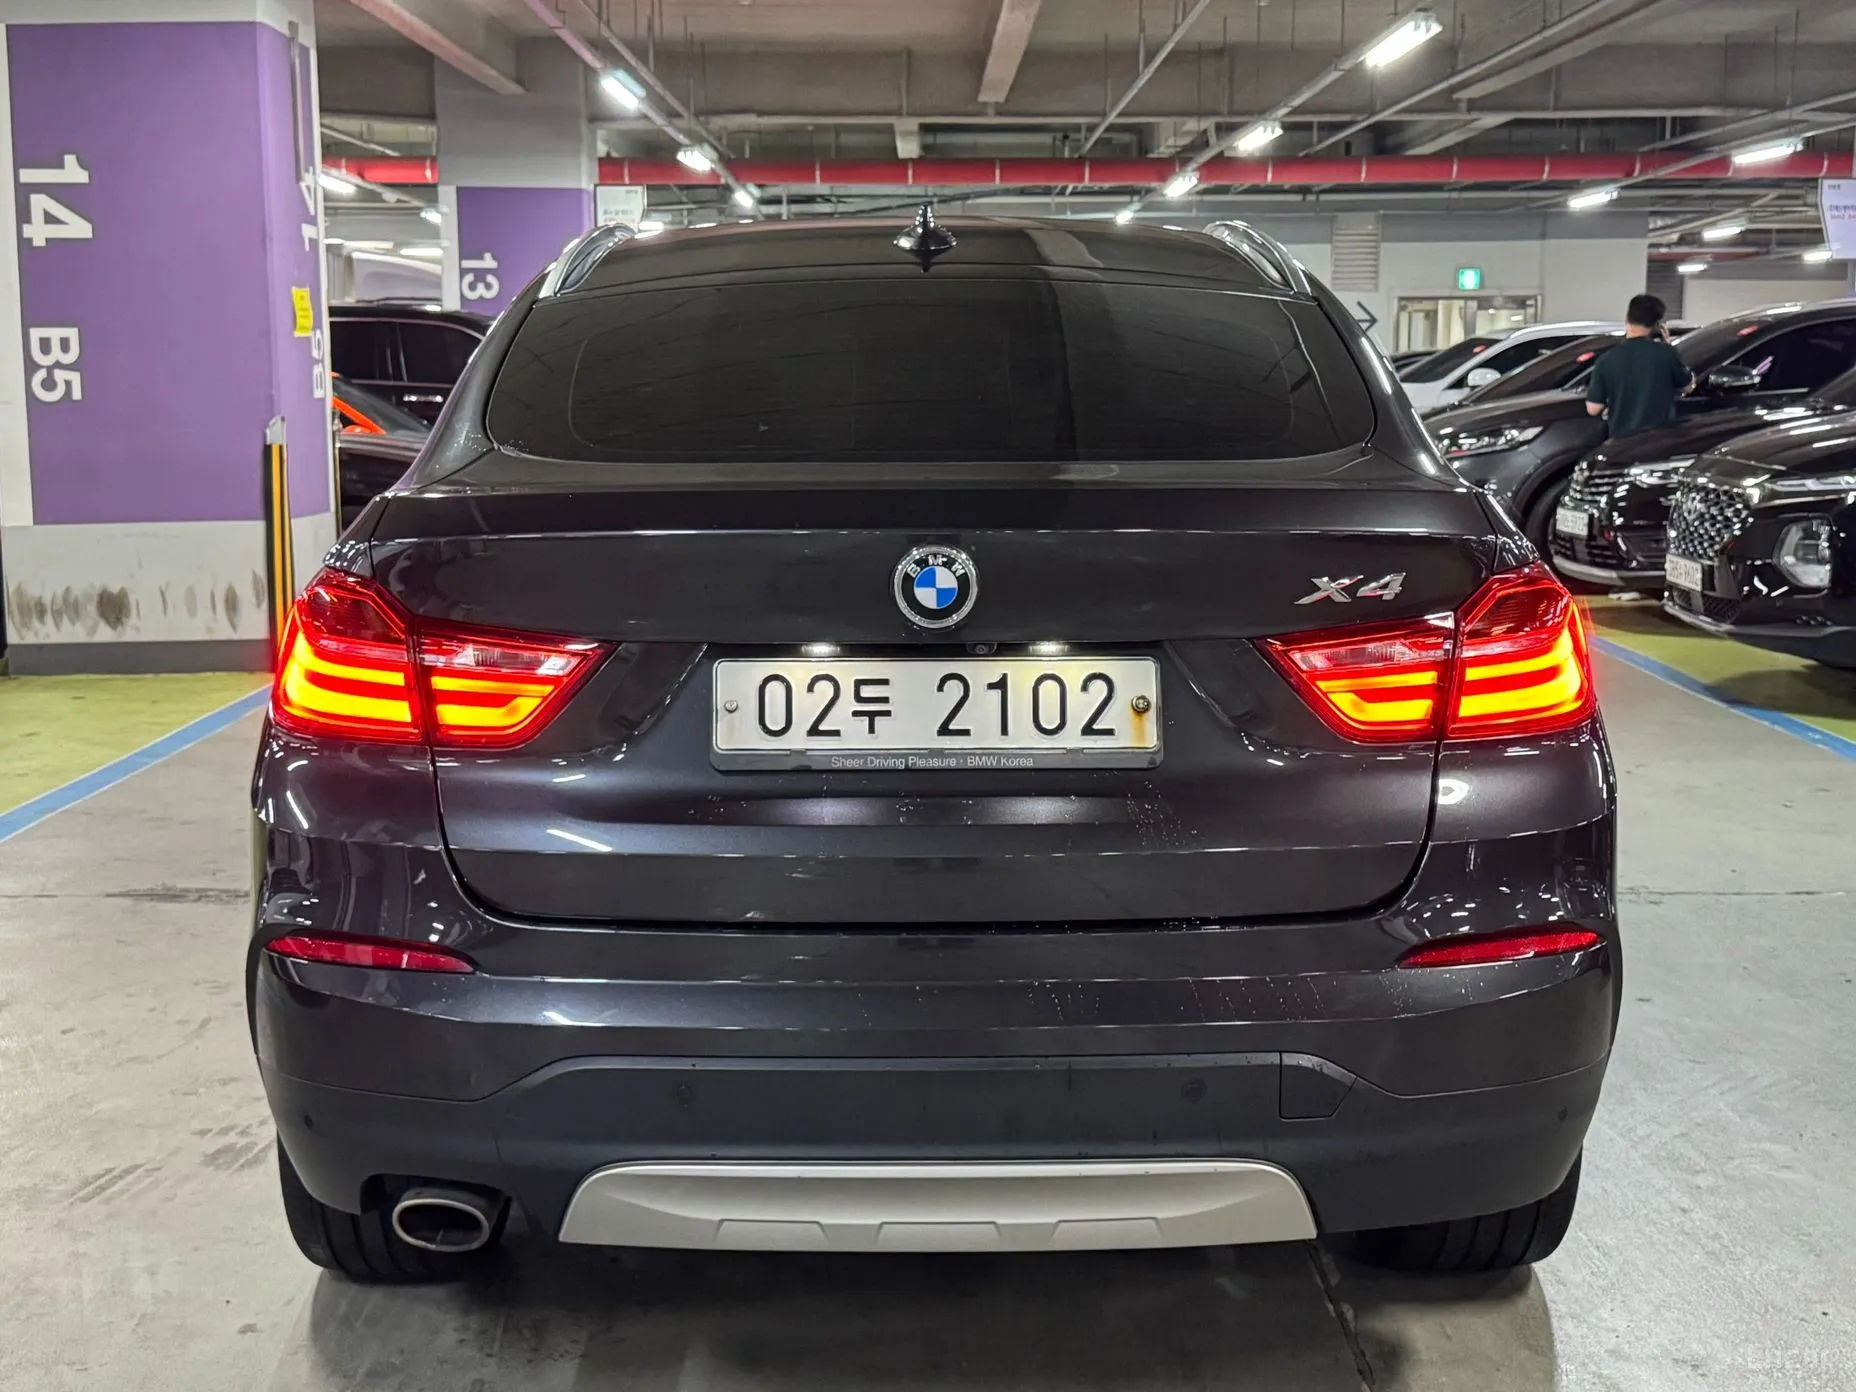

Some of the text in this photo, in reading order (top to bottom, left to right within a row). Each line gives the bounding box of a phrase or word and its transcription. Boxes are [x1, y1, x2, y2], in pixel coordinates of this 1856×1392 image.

[19, 154, 93, 402] 14 B5
[461, 252, 499, 300] 13
[907, 554, 966, 578] BMW
[1293, 572, 1406, 604] X4
[758, 672, 1116, 737] 02두 2102
[831, 755, 1034, 769] Sheer Driving Pleasure BMW Korea
